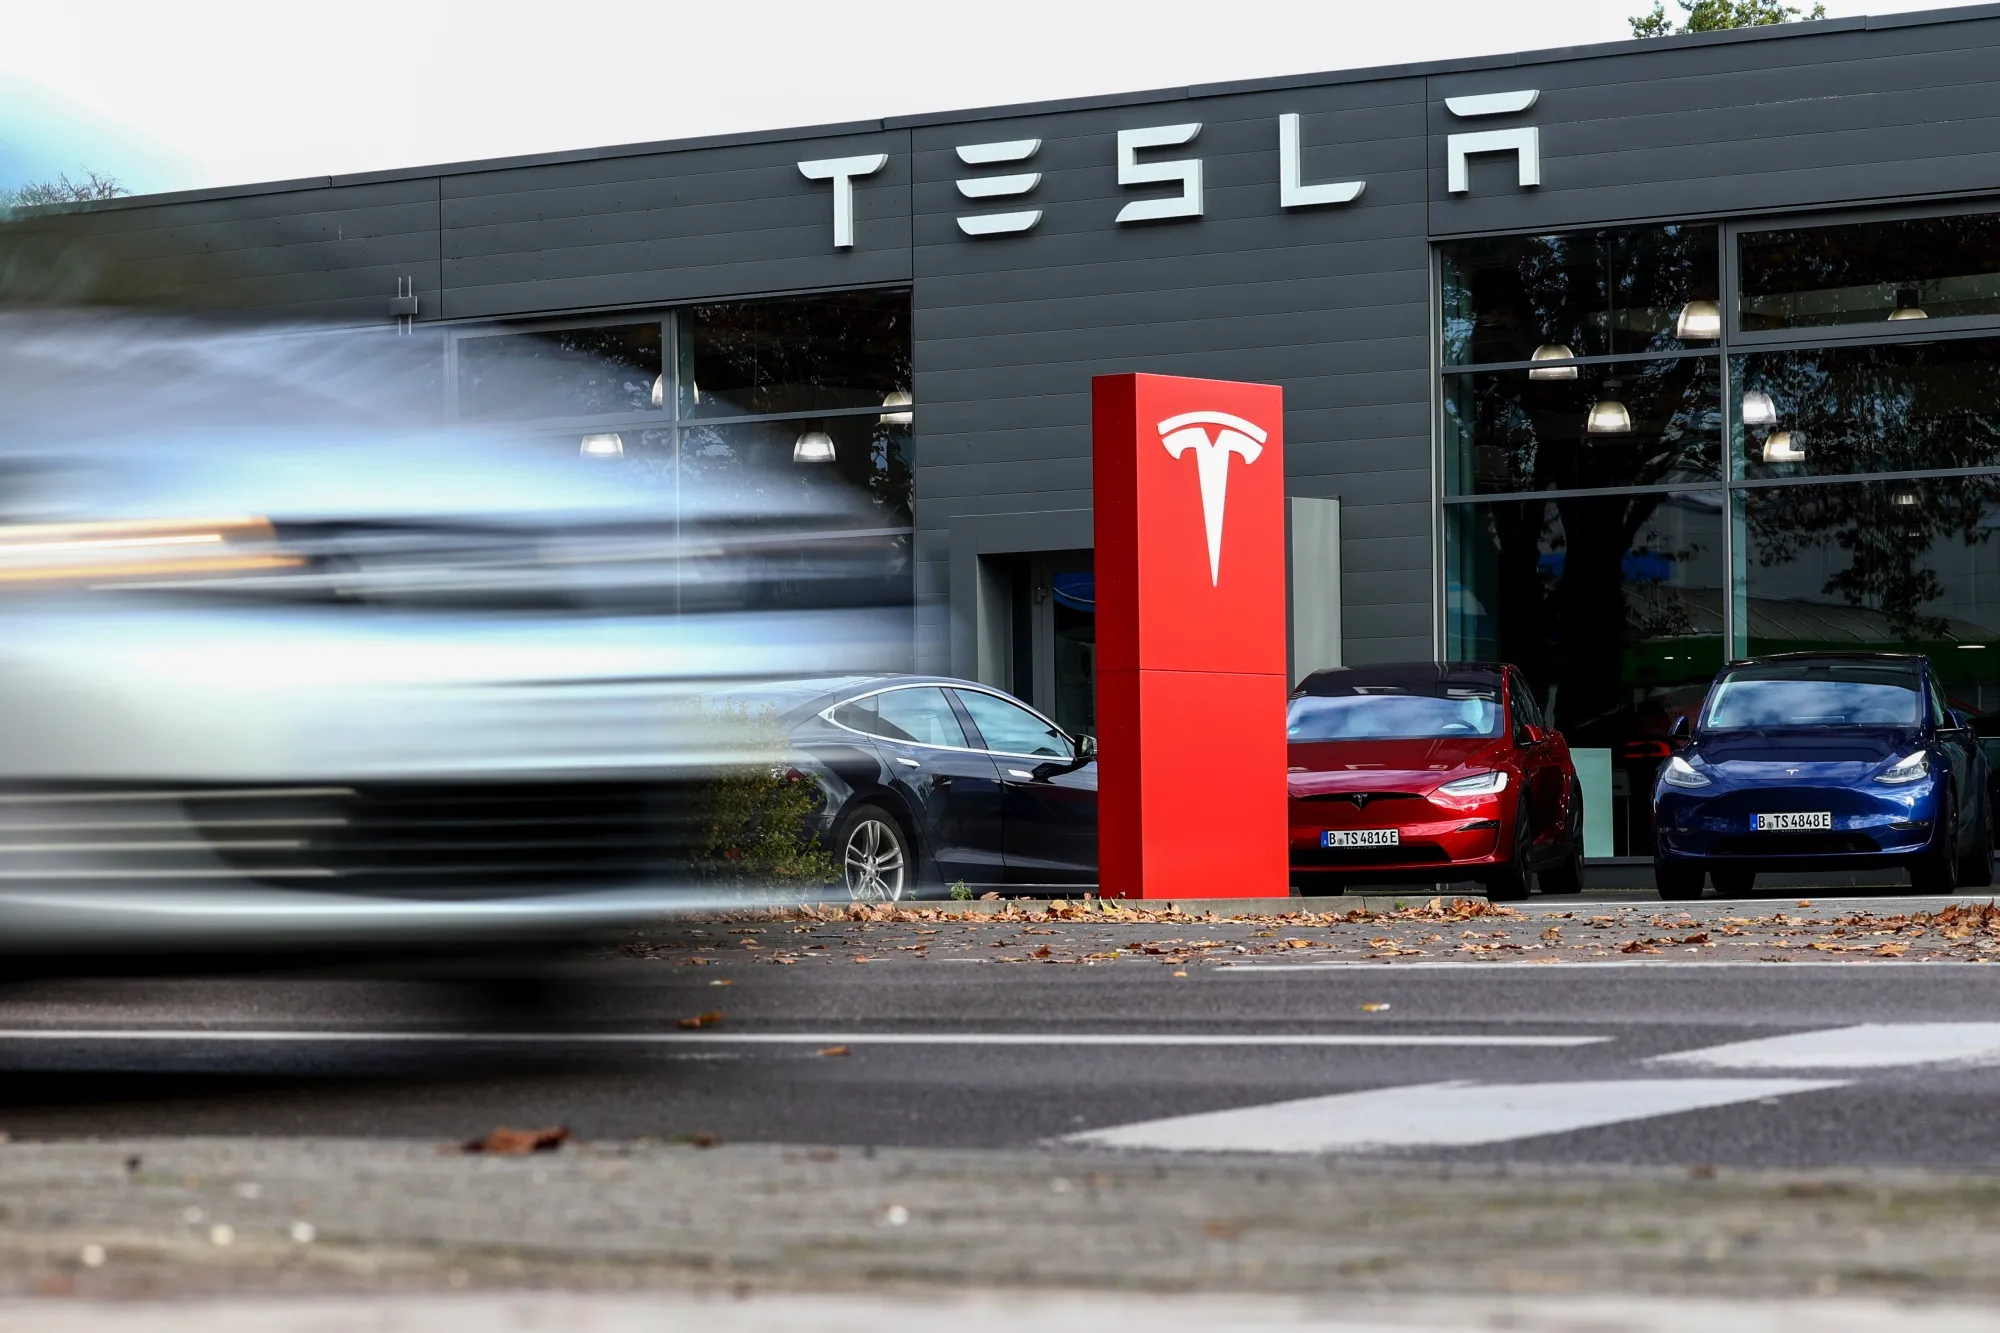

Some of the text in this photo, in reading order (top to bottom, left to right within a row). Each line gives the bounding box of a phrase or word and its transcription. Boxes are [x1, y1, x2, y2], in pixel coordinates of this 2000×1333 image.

[797, 89, 1541, 248] TESLA
[1758, 816, 1765, 828] B
[1329, 832, 1336, 845] B
